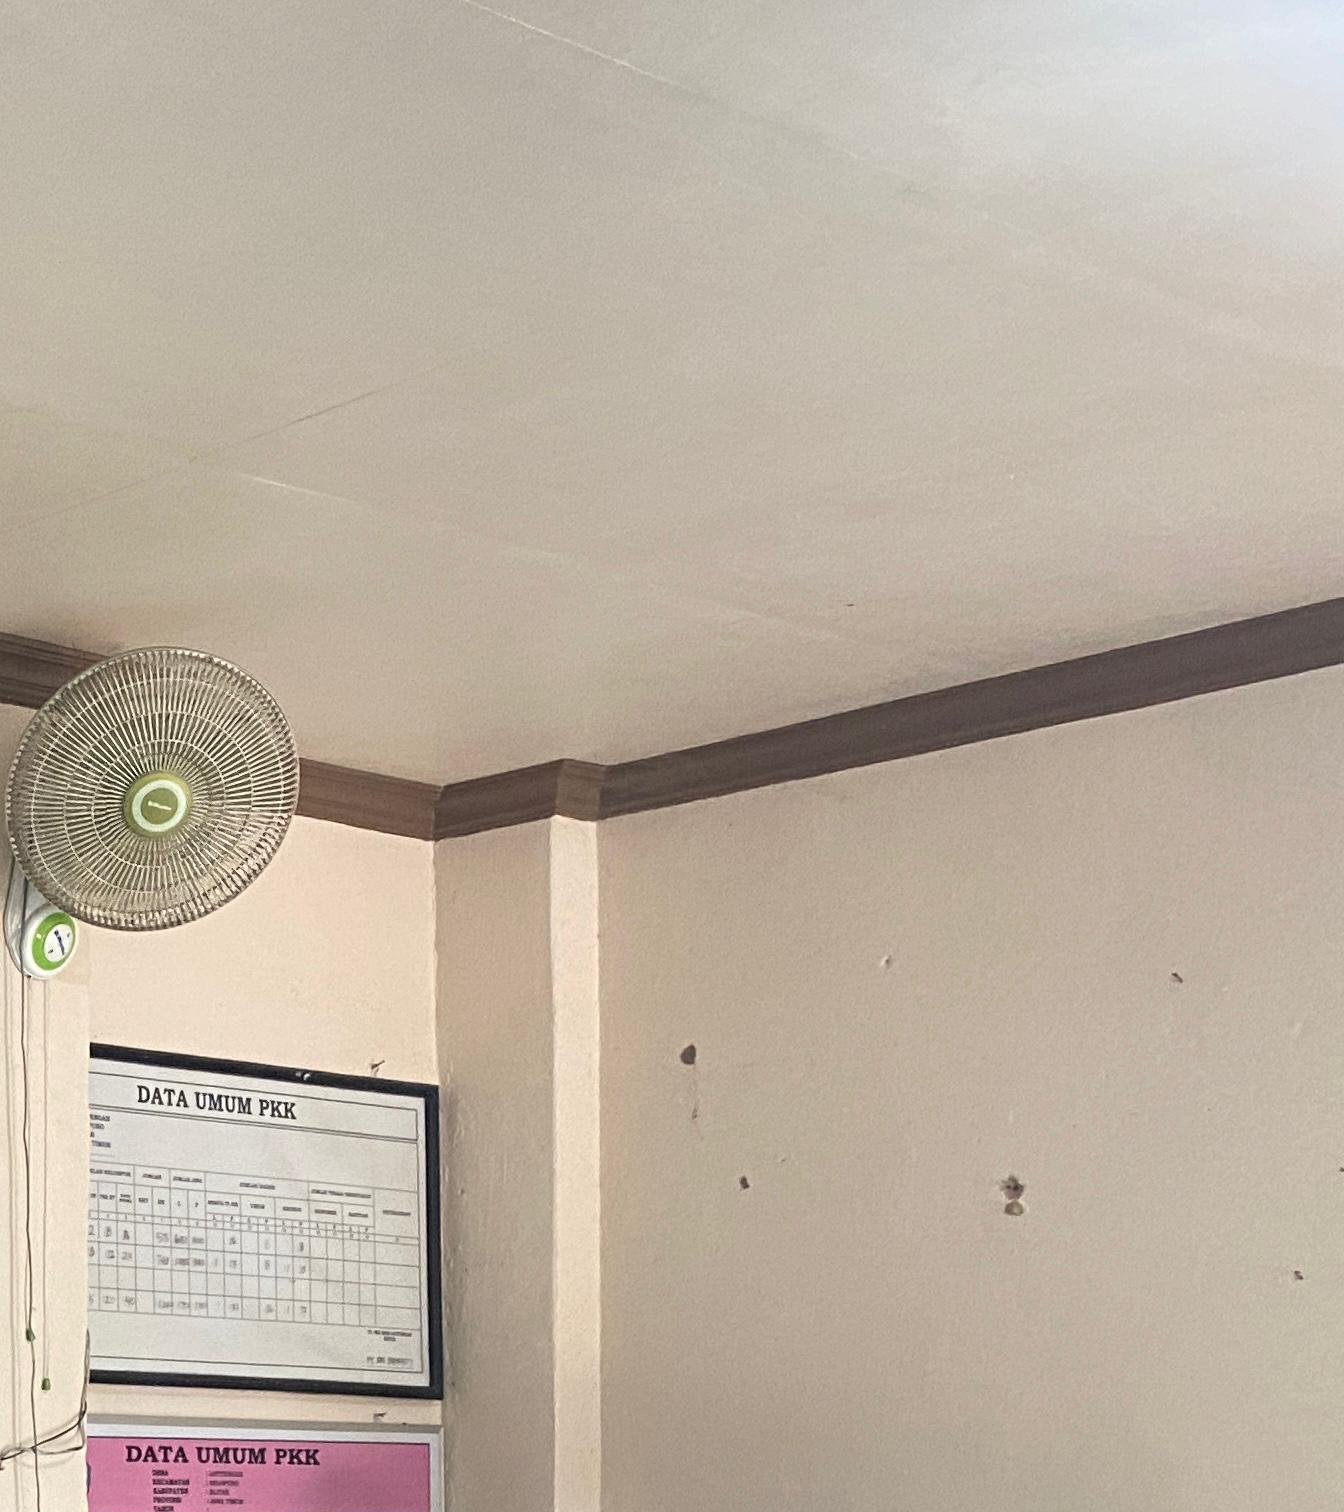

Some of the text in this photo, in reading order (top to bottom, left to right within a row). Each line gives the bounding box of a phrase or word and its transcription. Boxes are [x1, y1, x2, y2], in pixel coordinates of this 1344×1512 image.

[137, 1085, 297, 1121] DATA UMUM PKK
[126, 1445, 320, 1466] DATA UMUM PKK
